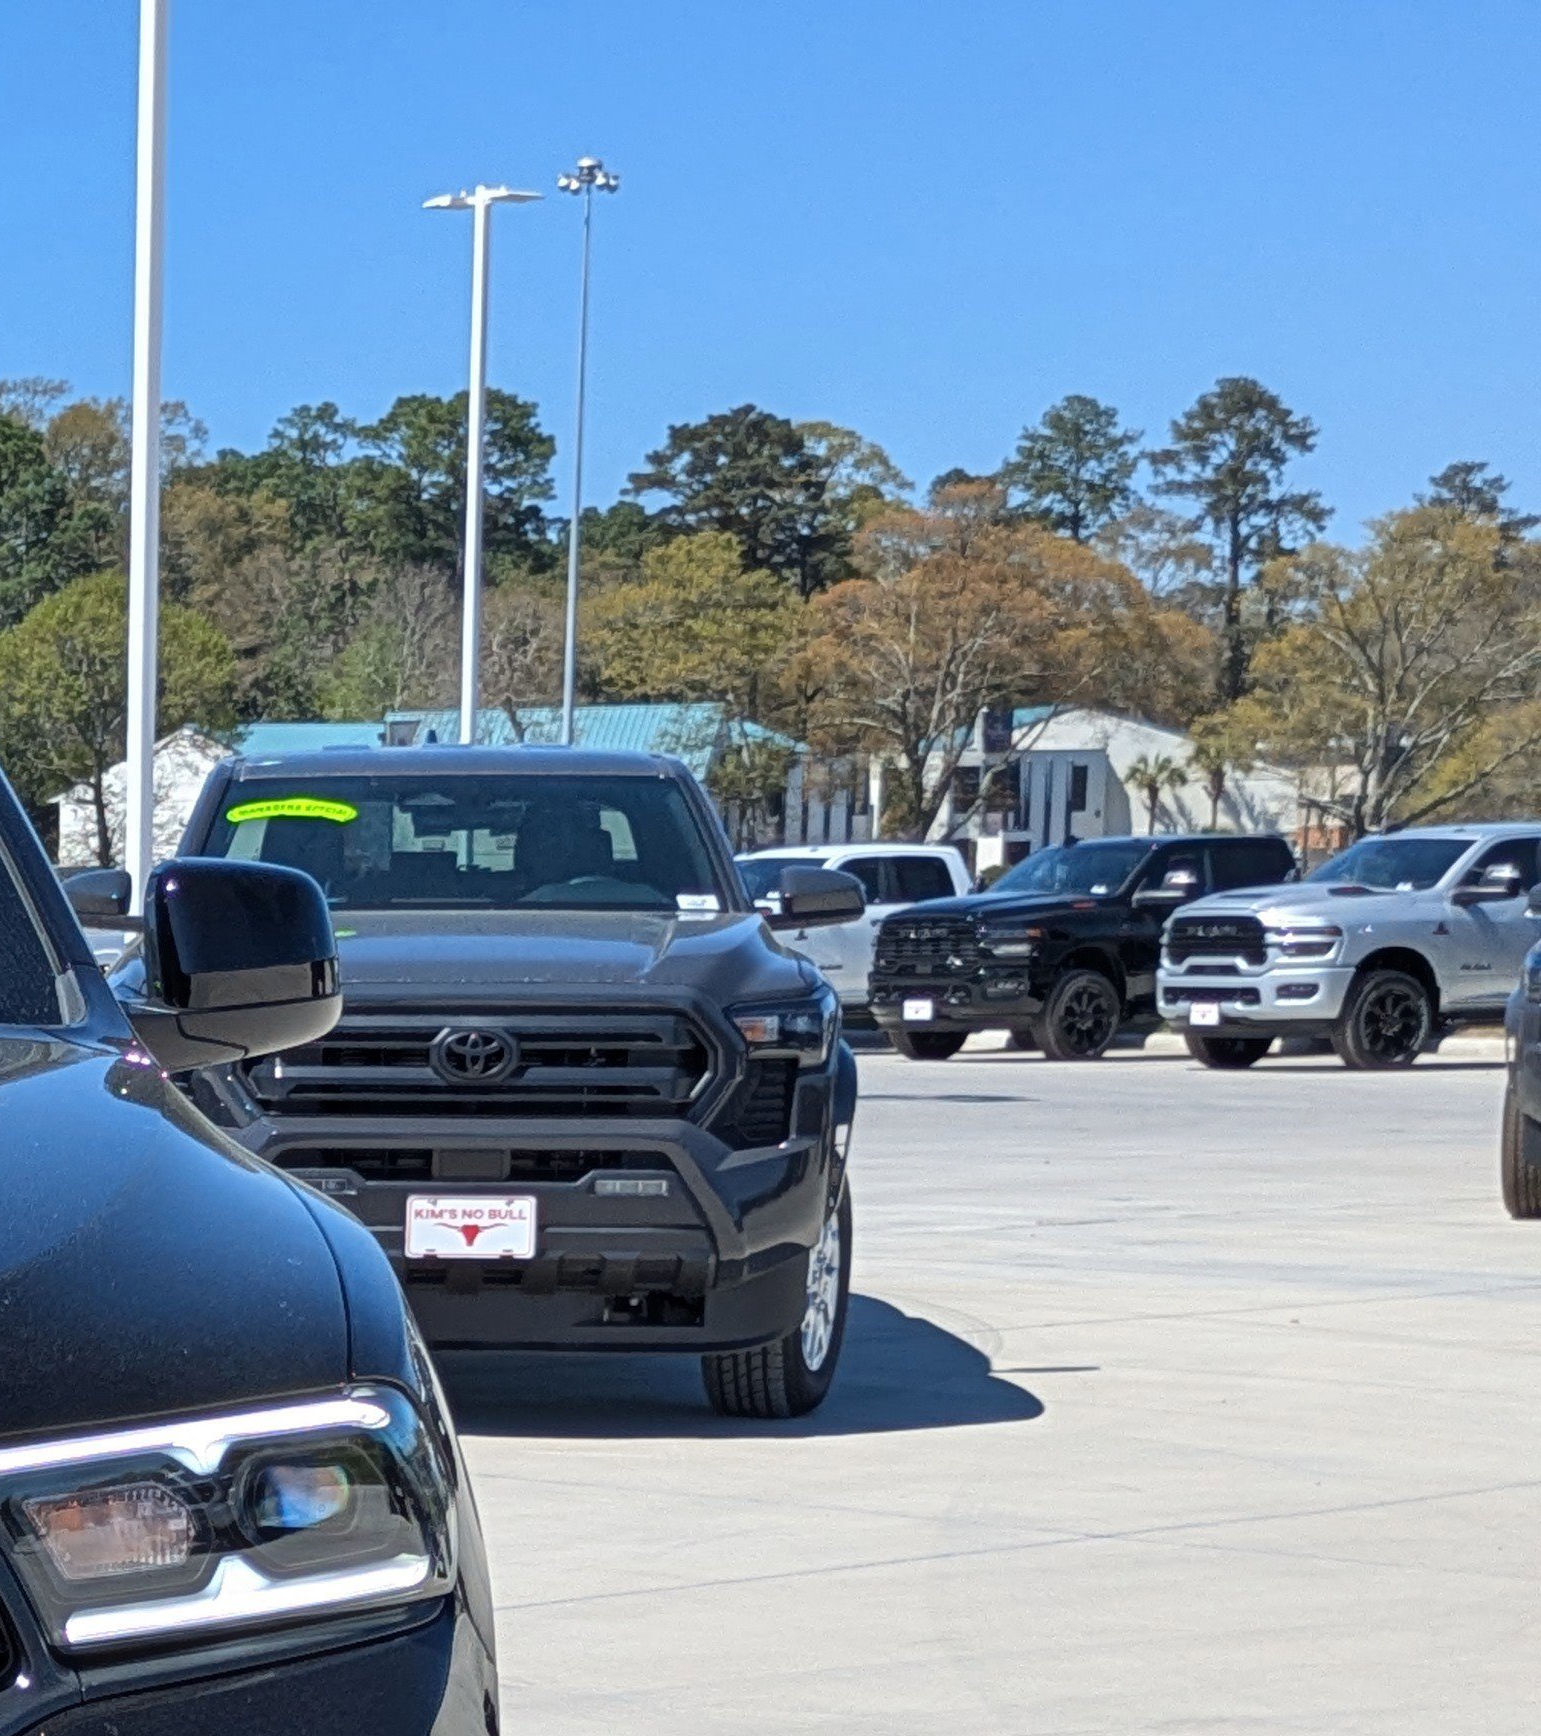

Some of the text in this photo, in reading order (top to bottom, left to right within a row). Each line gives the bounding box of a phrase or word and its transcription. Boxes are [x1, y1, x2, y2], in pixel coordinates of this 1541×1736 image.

[414, 1208, 527, 1220] KIM'S NO BULL
